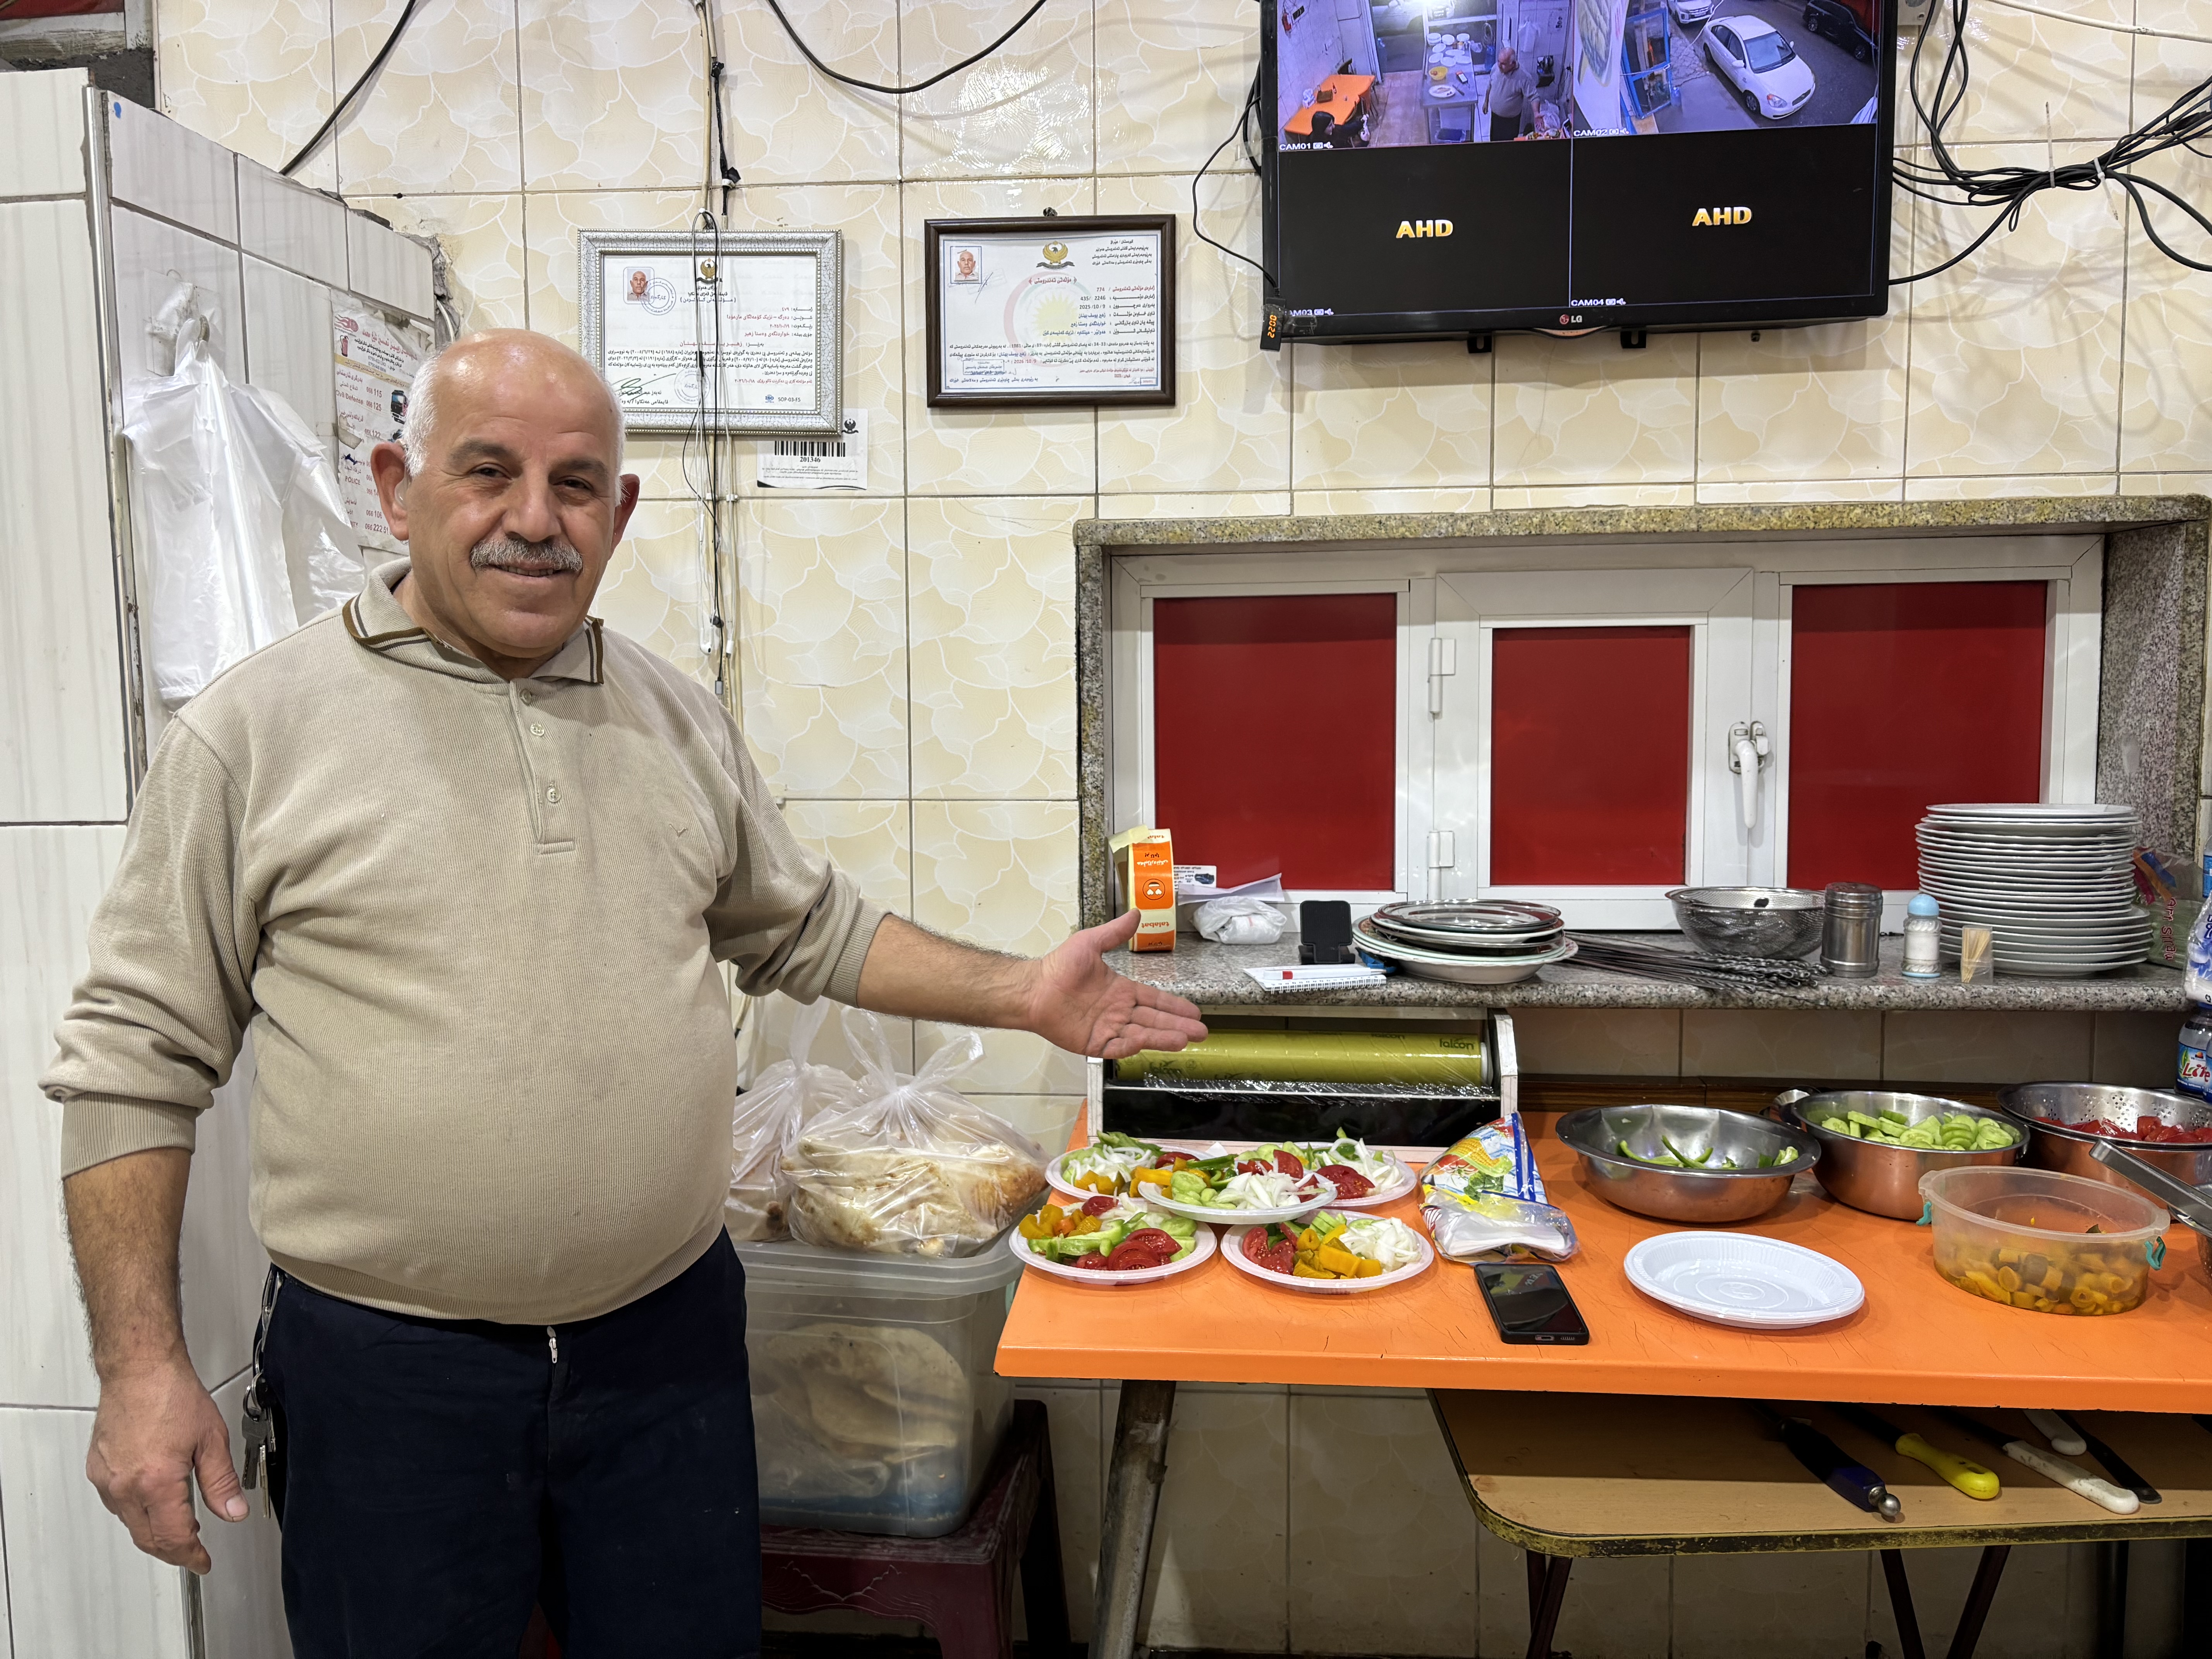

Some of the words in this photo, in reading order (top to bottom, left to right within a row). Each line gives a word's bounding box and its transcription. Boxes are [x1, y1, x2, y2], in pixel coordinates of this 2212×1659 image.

[1692, 206, 1752, 226] AHD
[1396, 219, 1453, 238] AHD
[346, 394, 363, 405] Defense
[374, 388, 382, 398] 115
[345, 476, 361, 485] POLICE
[373, 524, 383, 532] 222
[2163, 897, 2177, 921] Art
[2161, 926, 2177, 962] Straw
[1439, 1038, 1474, 1050] falcon
[2182, 1062, 2210, 1082] Life
